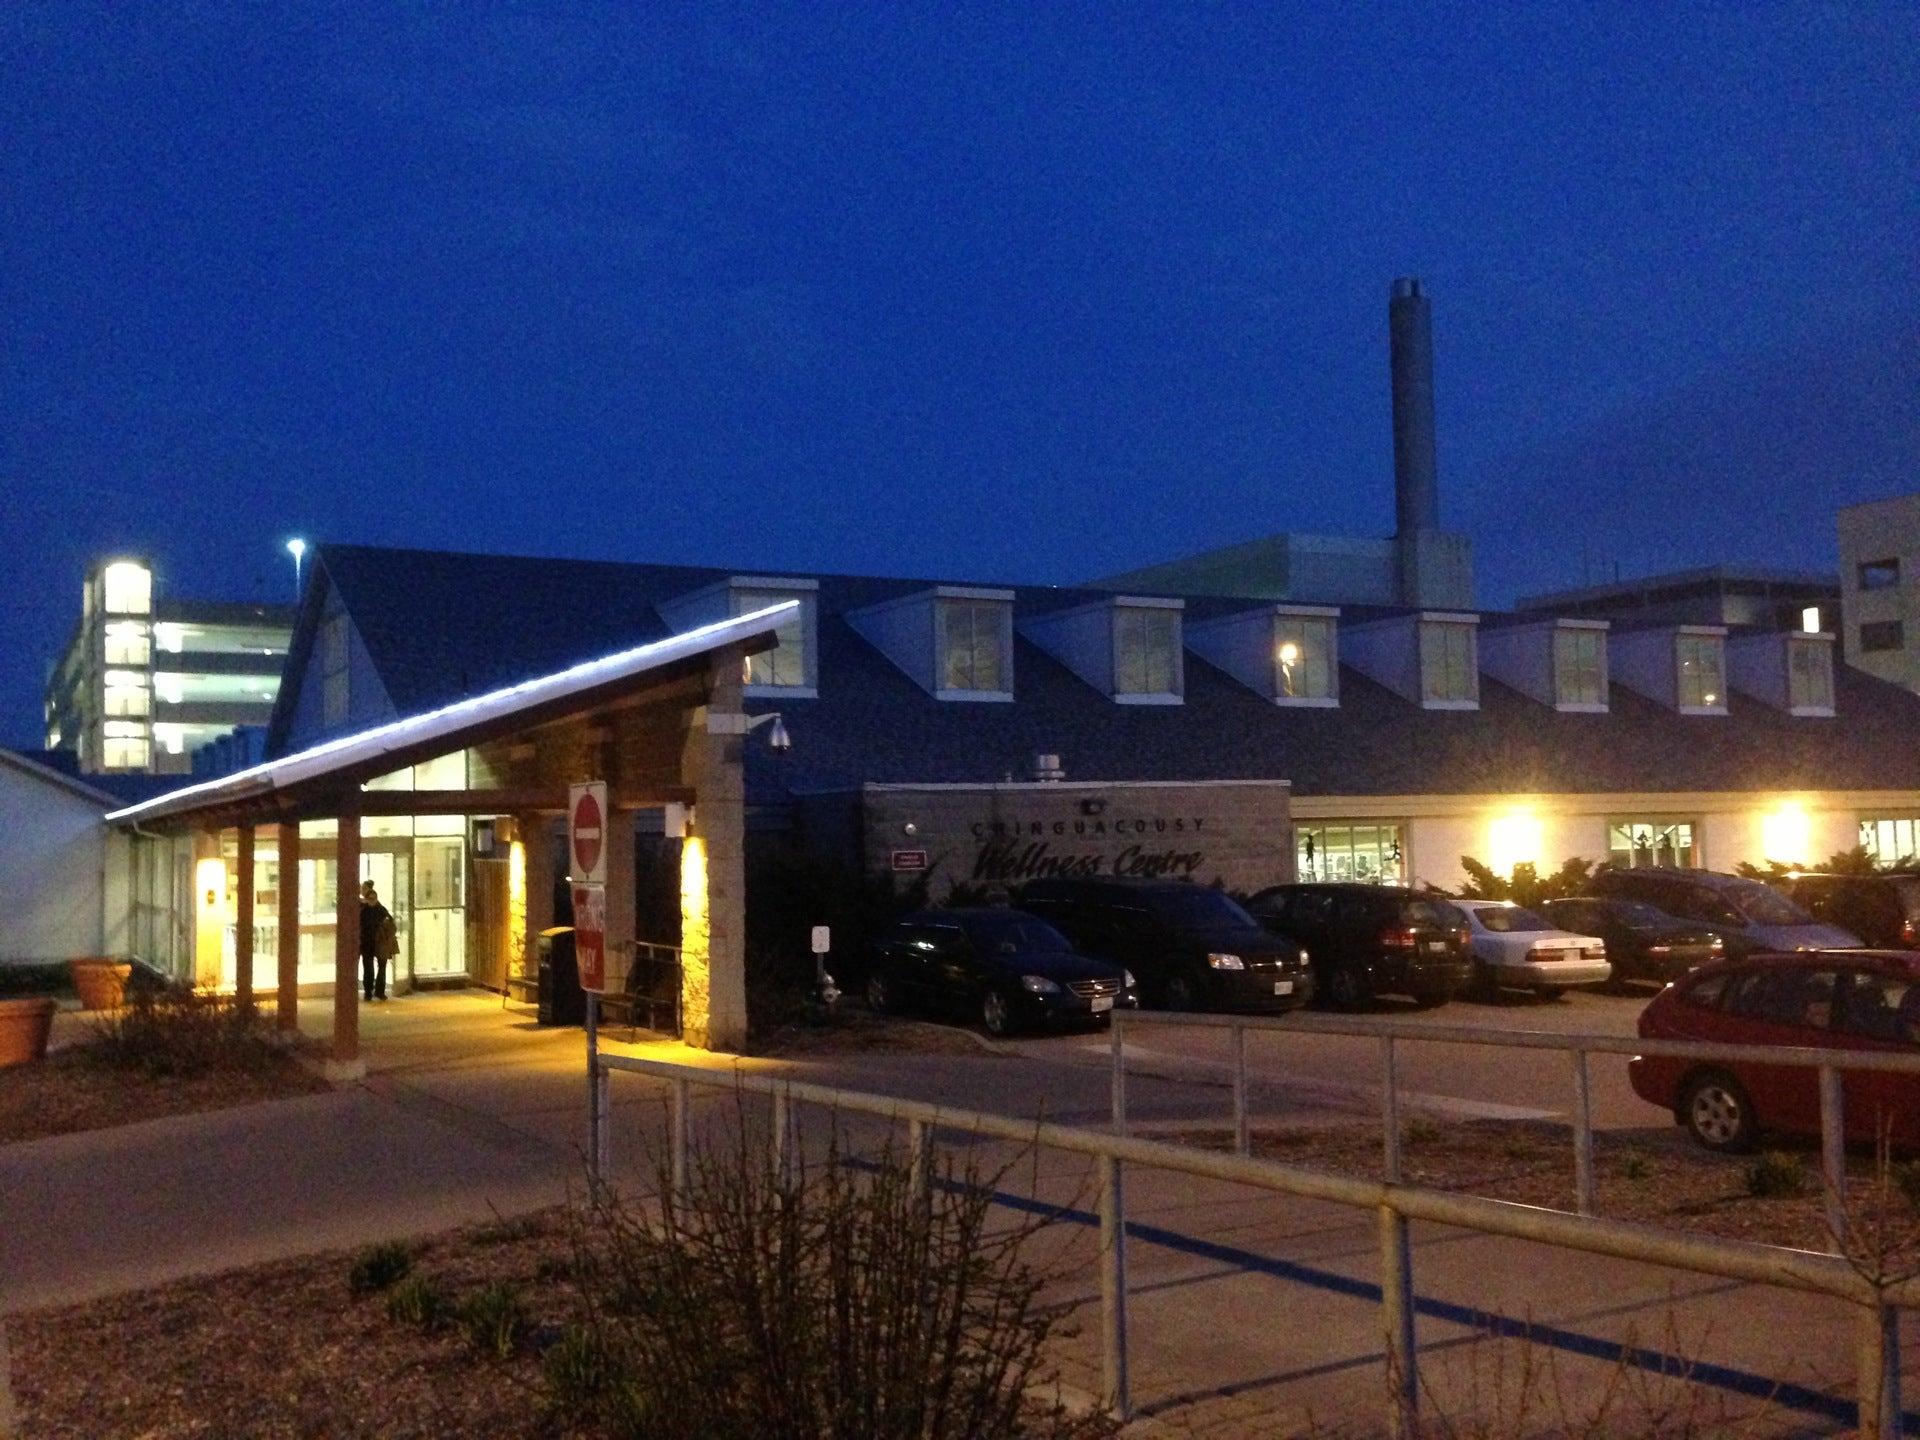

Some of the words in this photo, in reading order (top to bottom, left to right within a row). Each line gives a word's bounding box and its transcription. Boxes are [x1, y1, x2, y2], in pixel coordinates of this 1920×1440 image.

[973, 819, 1203, 837] CHINGUACOUSY
[973, 842, 1104, 880] Wellness
[1115, 846, 1203, 875] Centre
